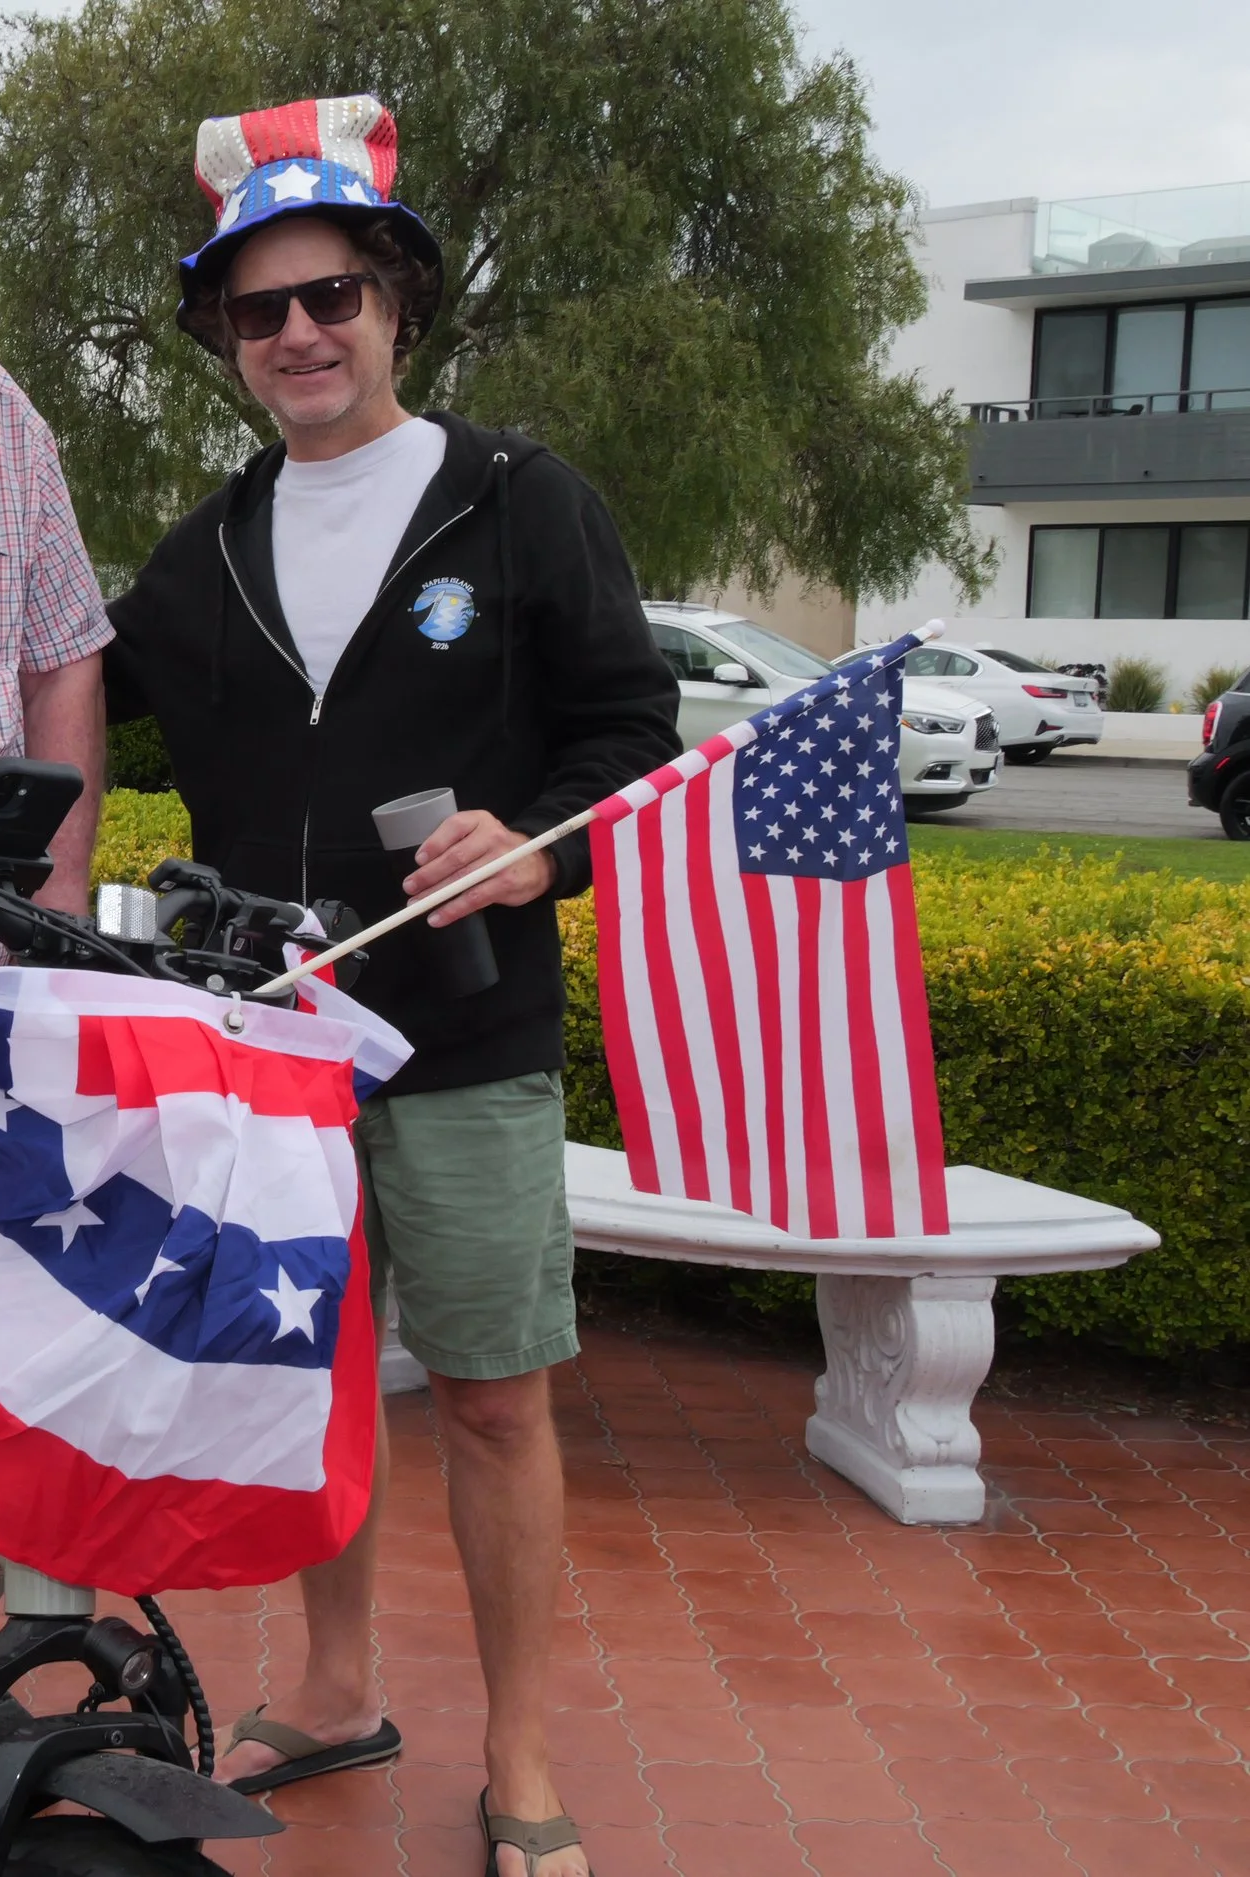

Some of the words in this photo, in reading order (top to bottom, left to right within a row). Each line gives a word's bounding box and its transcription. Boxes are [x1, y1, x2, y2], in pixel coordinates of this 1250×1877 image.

[422, 577, 449, 590] NAPLES
[450, 577, 474, 593] ISLAND
[431, 642, 449, 650] 2026
